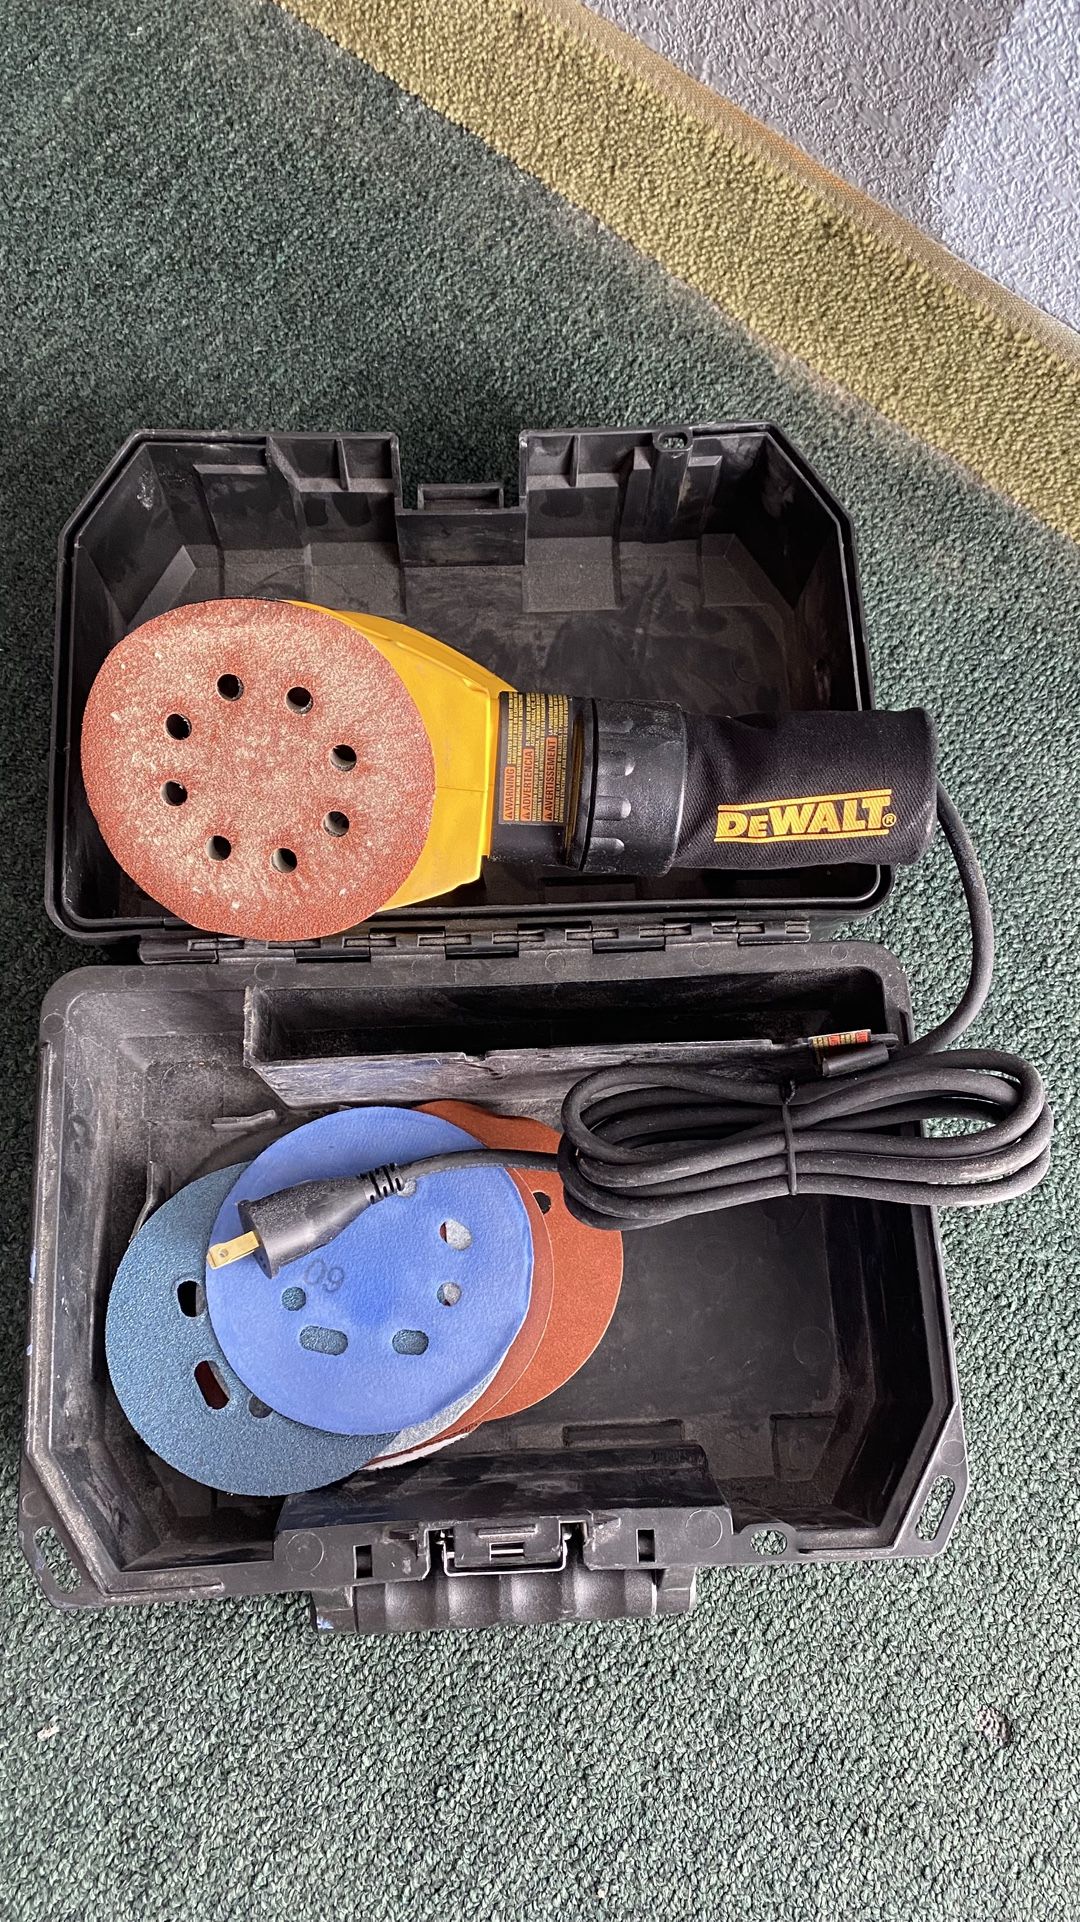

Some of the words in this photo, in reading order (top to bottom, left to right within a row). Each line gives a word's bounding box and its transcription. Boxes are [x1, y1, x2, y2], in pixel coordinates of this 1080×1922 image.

[505, 769, 514, 810] WARNING
[523, 752, 532, 811] ADVERTENCIA
[545, 740, 555, 811] AVERTISSEMENT
